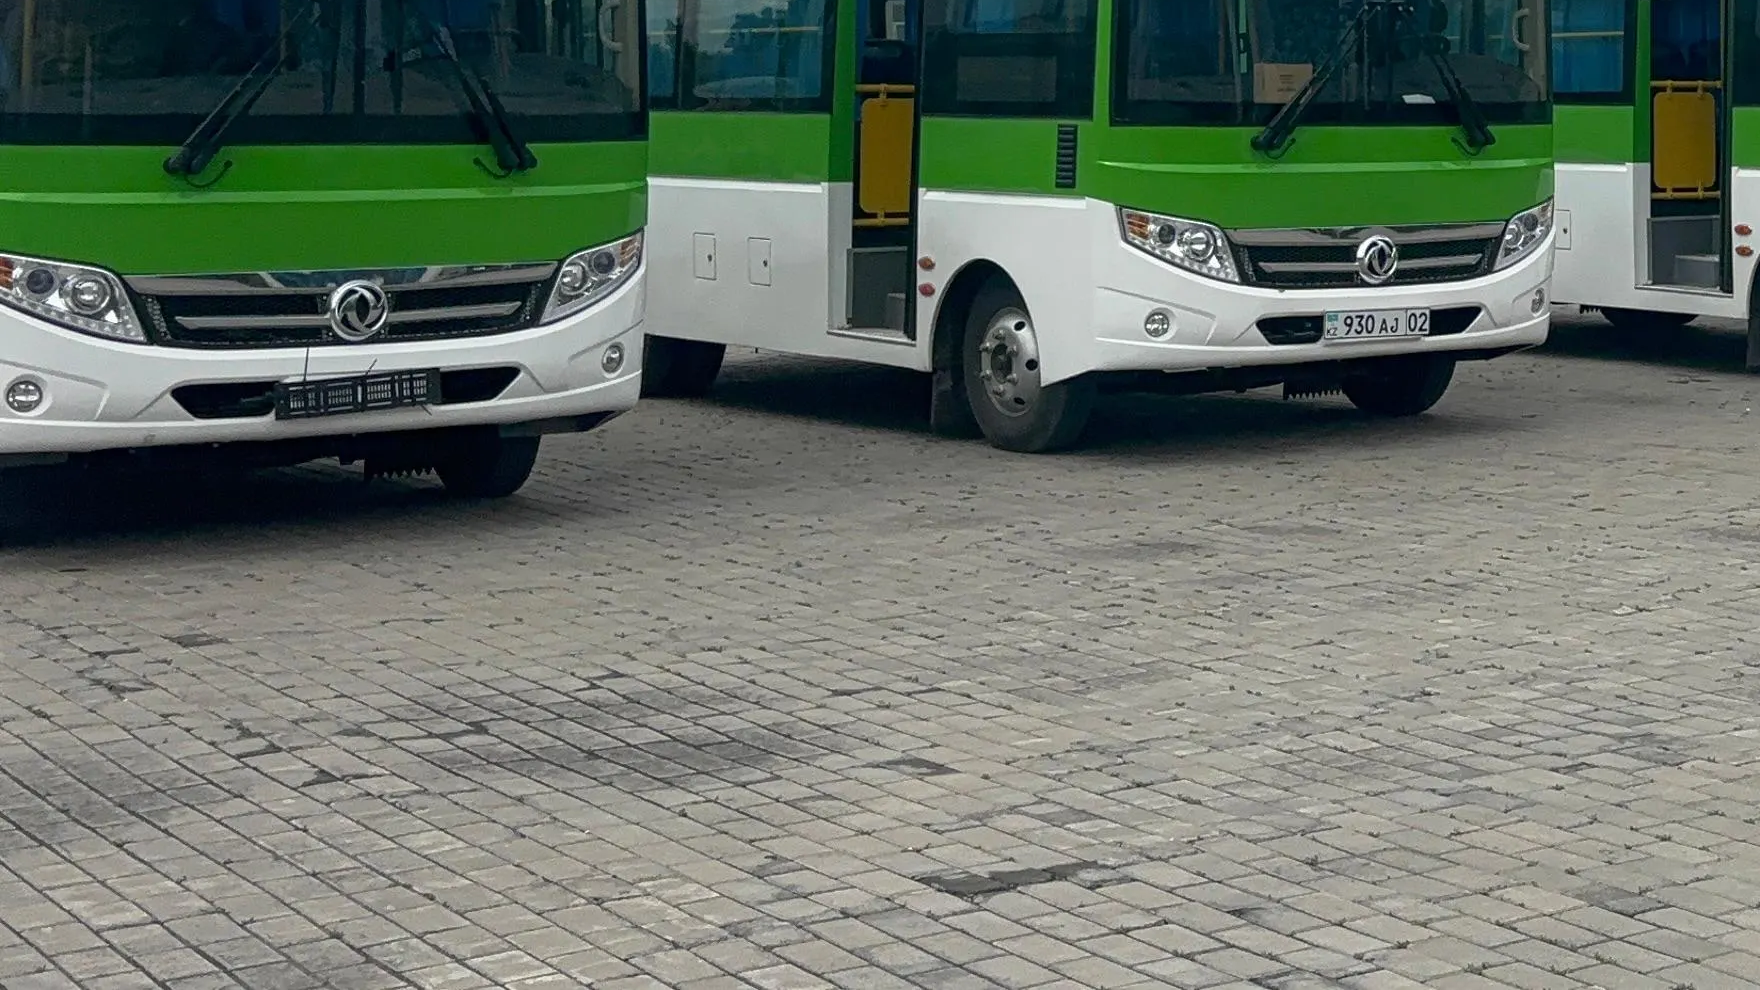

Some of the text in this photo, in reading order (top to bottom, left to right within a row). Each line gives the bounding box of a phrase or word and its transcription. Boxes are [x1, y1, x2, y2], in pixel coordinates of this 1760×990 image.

[1327, 327, 1337, 336] KZ
[1343, 312, 1428, 335] 930 AJ 02
